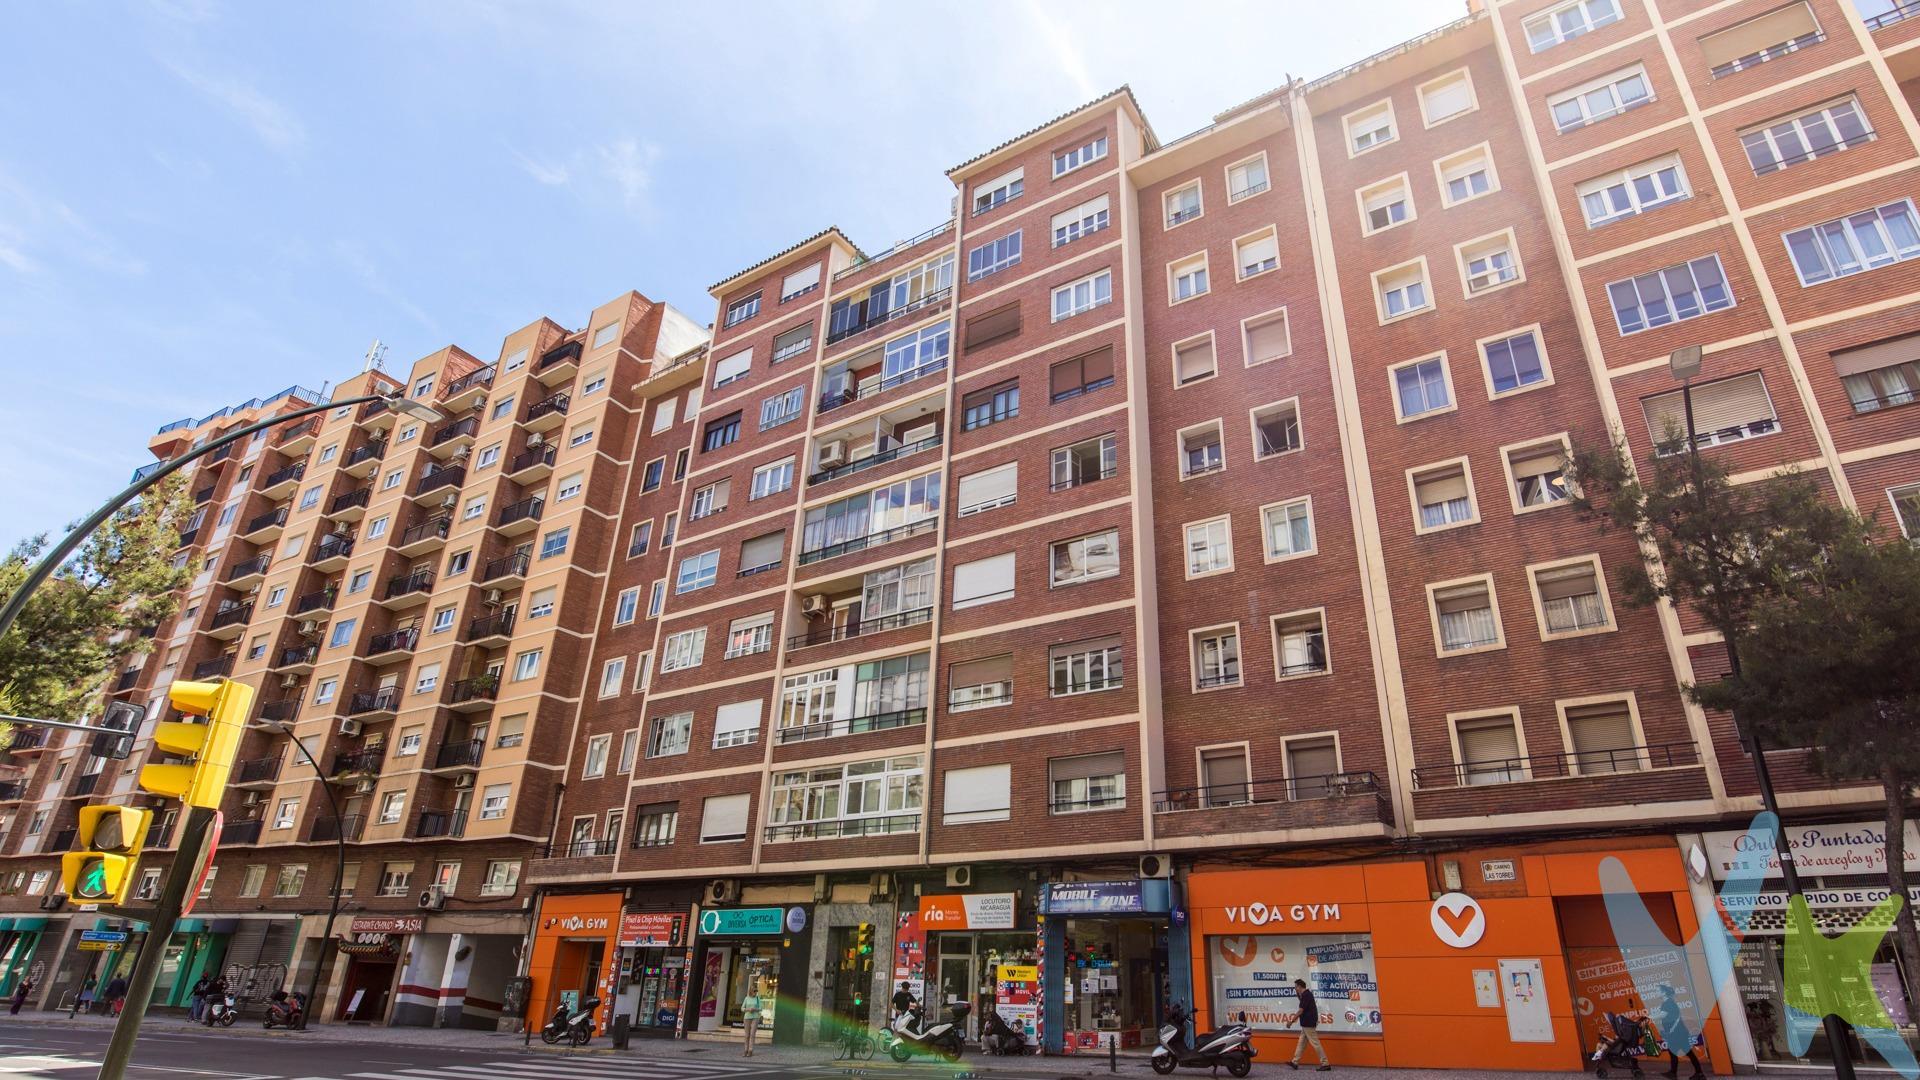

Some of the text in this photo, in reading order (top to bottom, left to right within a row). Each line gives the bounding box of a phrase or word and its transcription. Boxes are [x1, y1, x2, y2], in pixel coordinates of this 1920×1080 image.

[1733, 829, 1887, 852] Dules Puntada
[1800, 854, 1814, 866] de
[1816, 850, 1863, 870] arreglos
[1865, 857, 1873, 870] y
[1051, 889, 1099, 901] MOBILE
[1101, 895, 1139, 906] ZONE
[1720, 894, 1782, 907] SERVICIO
[1789, 893, 1840, 904] PIDO
[1844, 892, 1863, 902] DE
[924, 904, 944, 921] ria
[1225, 902, 1340, 925] VIVA GYM
[404, 919, 422, 931] ASIA
[561, 915, 609, 931] VIVA GYM
[1309, 946, 1335, 955] AMPLIO
[1328, 952, 1361, 961] APERTURA
[1579, 951, 1677, 979] SIN PERMANENCIA
[1313, 973, 1367, 981] GRAN VARIEDAD
[1329, 982, 1376, 990] ACTIVIDADES
[1587, 984, 1606, 993] CON
[1607, 979, 1631, 990] GRAN
[1243, 989, 1297, 997] PERMANENCIA
[1313, 990, 1349, 998] DIRIGIDAS
[1600, 991, 1612, 1000] DE
